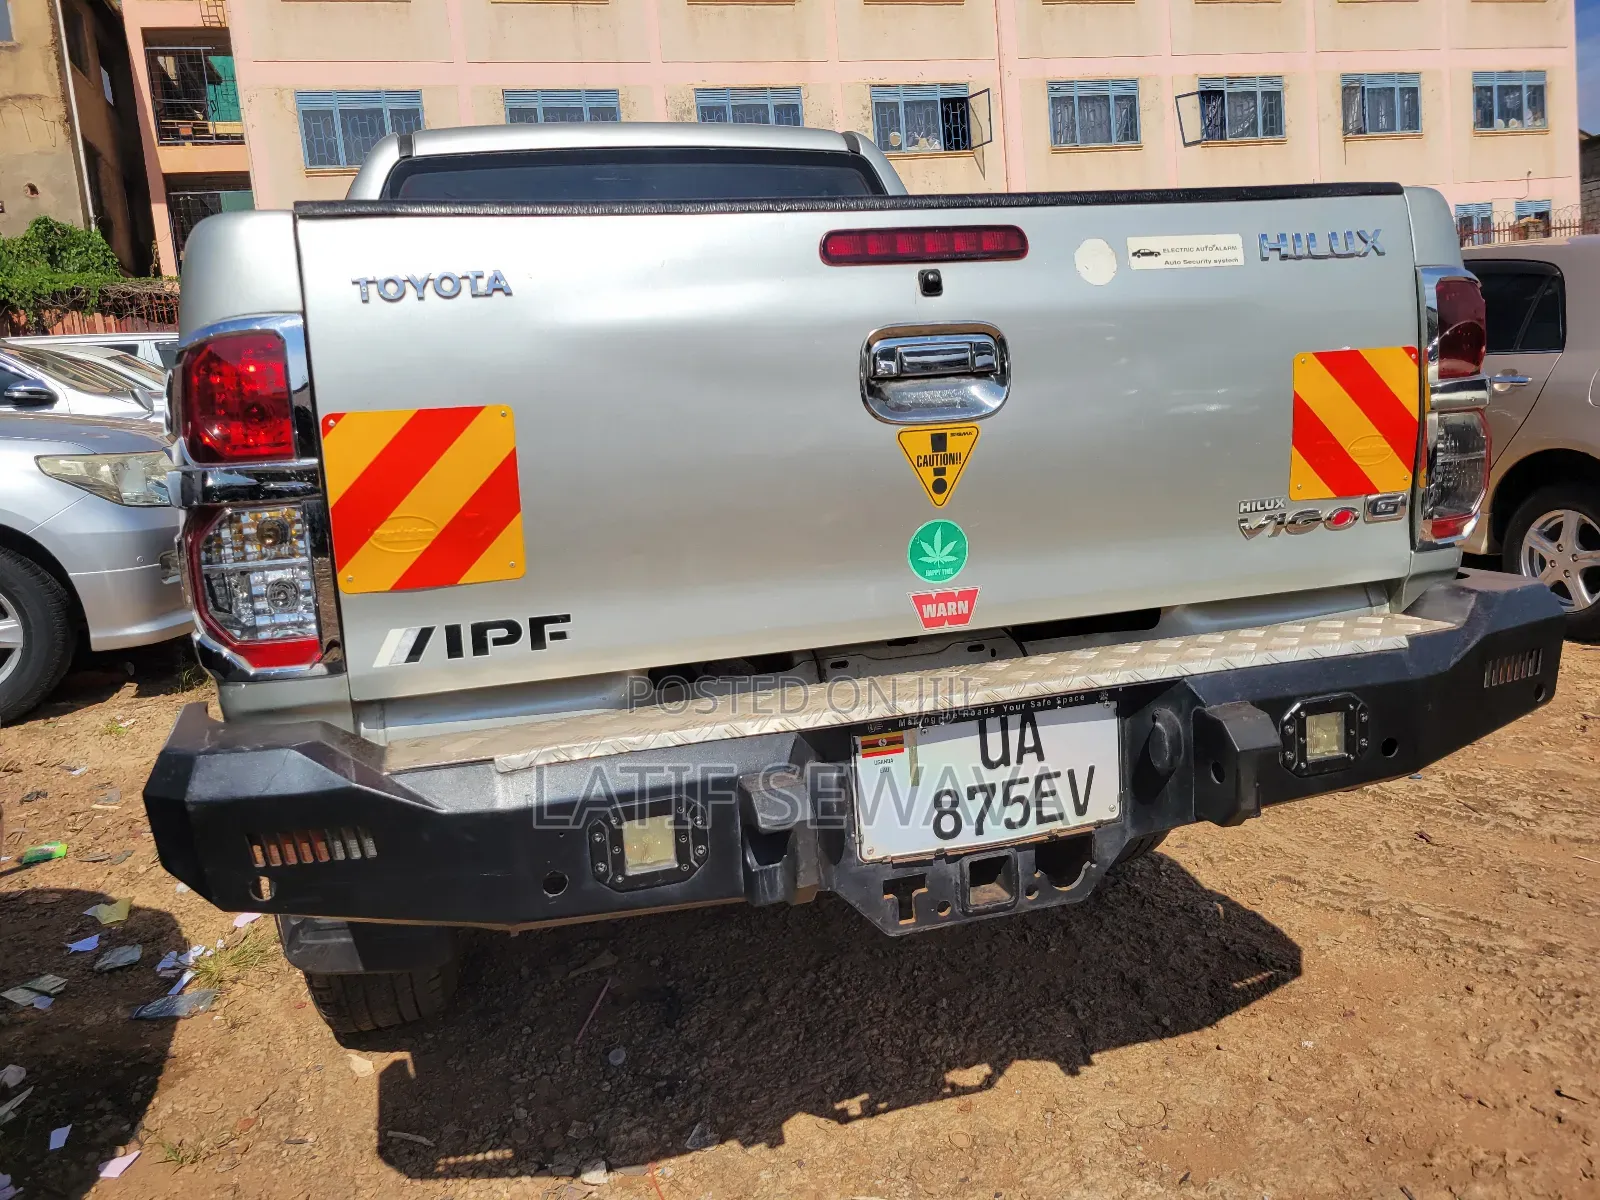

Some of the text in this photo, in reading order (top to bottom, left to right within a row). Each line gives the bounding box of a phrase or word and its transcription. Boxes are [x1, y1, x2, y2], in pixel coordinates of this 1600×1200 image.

[1257, 228, 1386, 262] HILUX
[351, 269, 513, 303] TOYOTA
[916, 452, 962, 467] CAUTION!!
[1238, 497, 1287, 514] HILUX
[1238, 506, 1361, 540] VIGO
[925, 567, 954, 577] HAPPY TIME
[922, 600, 969, 618] WARN
[445, 613, 572, 659] IPF
[898, 717, 936, 728] Making
[962, 707, 995, 718] Roads
[1002, 703, 1026, 712] Your
[1030, 699, 1052, 708] Safe
[1056, 694, 1085, 706] Space
[977, 711, 1045, 770] UA
[932, 765, 1095, 841] 875EV
